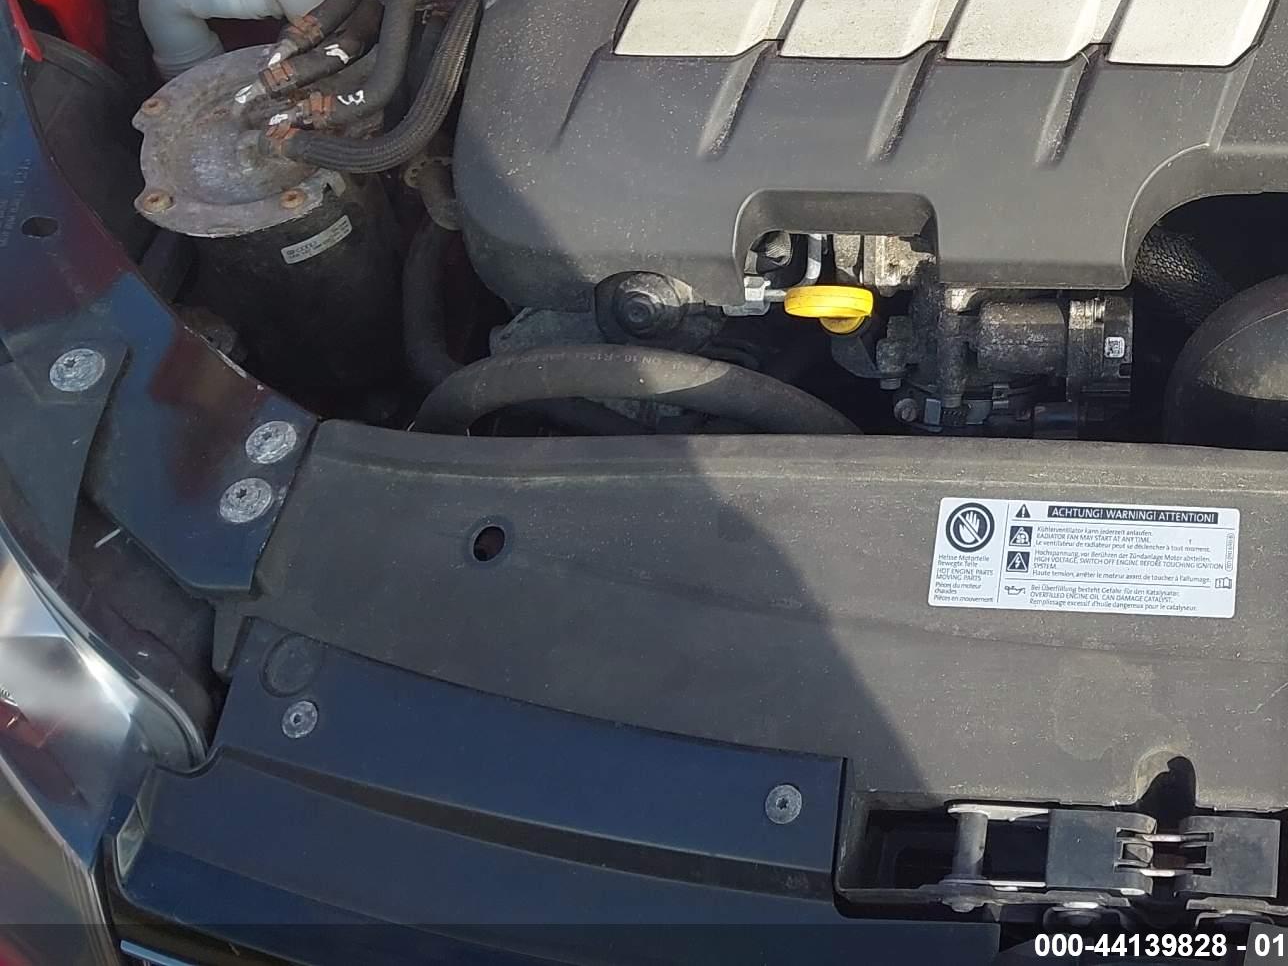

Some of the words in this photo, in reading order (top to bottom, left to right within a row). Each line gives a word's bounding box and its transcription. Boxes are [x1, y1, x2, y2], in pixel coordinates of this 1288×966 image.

[1051, 507, 1103, 518] ACHTUNG!
[1105, 509, 1156, 520] WARNING!
[1158, 511, 1214, 522] ATTENTION!
